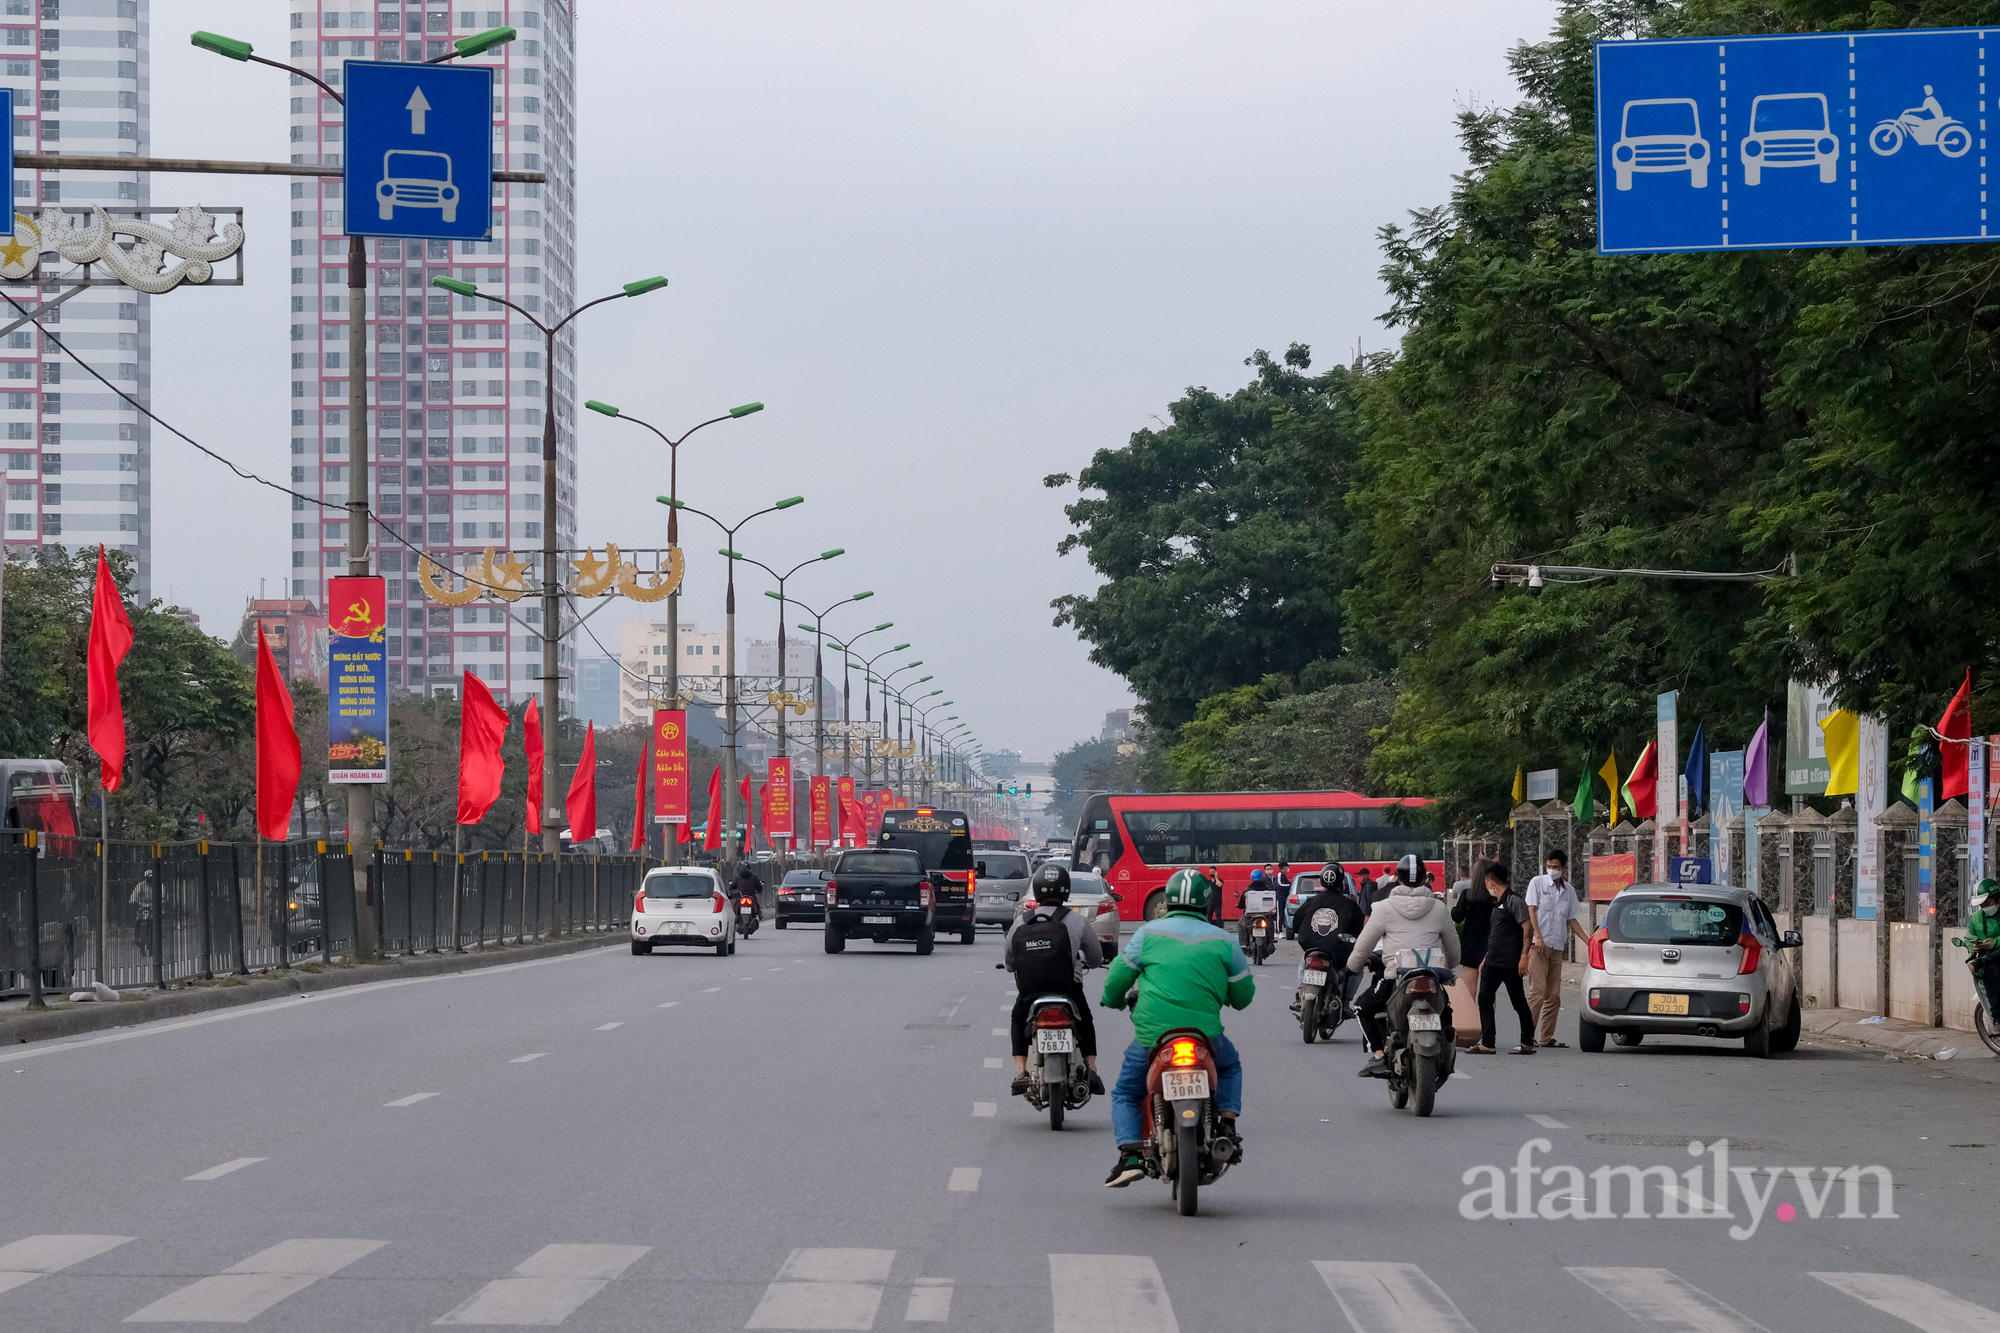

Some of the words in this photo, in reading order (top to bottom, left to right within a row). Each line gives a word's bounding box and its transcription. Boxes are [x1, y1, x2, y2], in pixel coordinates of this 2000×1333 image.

[332, 771, 348, 780] QUẬN
[350, 771, 370, 779] HOÀNG
[663, 778, 678, 786] 2022
[1661, 995, 1677, 1004] 30A
[1653, 1004, 1684, 1013] 503.30
[1043, 1031, 1067, 1040] 36-B2
[1041, 1041, 1070, 1051] 768.71
[1170, 1072, 1201, 1085] 29-X4
